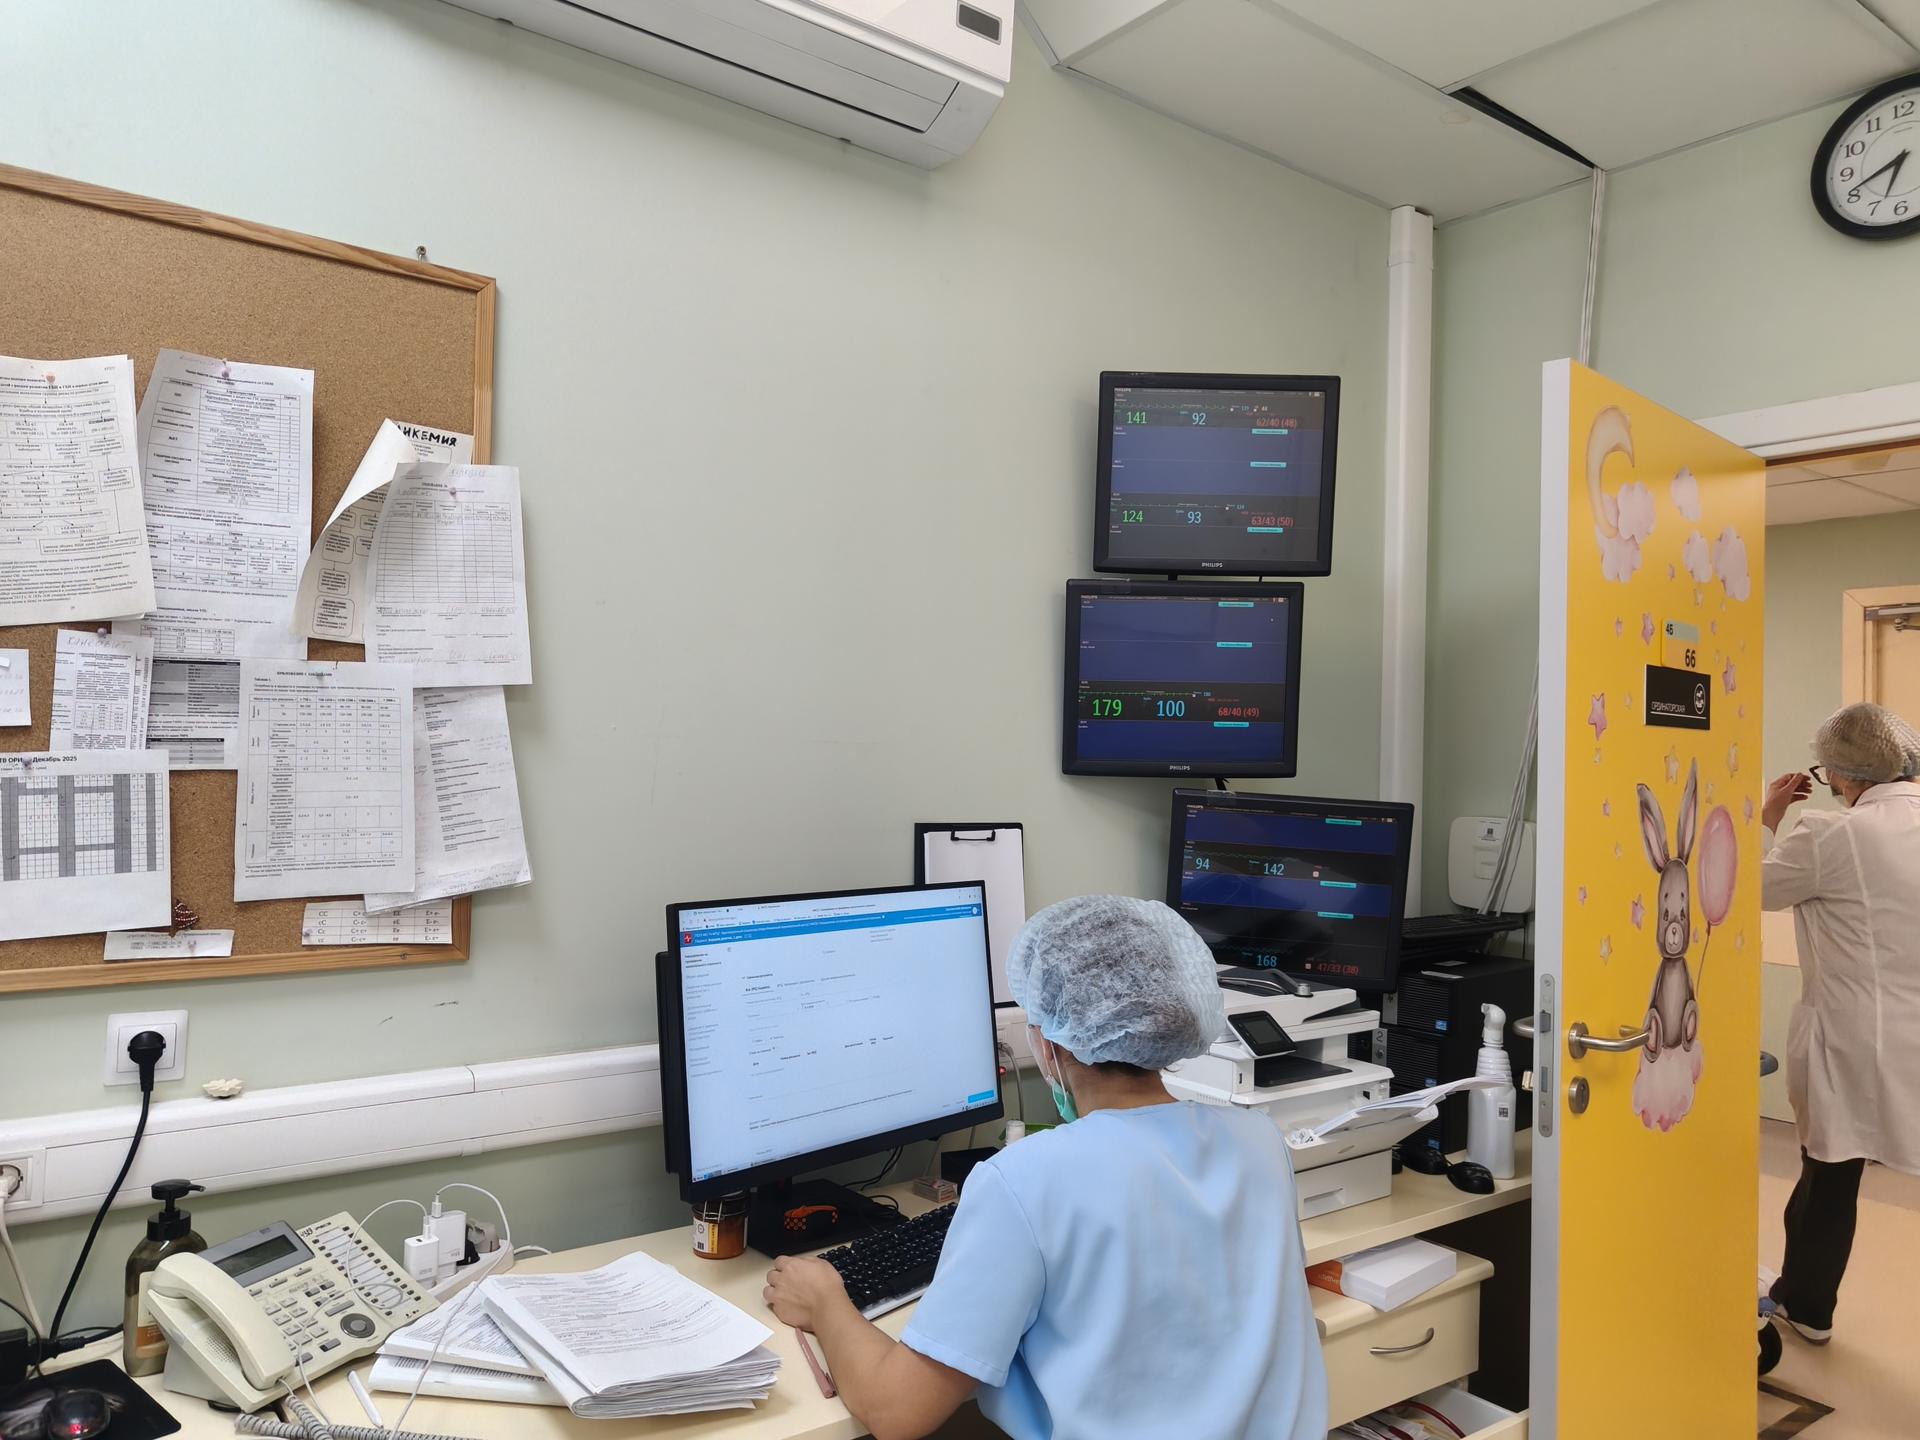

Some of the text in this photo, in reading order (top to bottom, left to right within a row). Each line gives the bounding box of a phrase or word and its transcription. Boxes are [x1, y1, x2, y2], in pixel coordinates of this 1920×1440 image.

[1893, 100, 1915, 119] 12
[1866, 117, 1881, 133] 11
[1845, 140, 1866, 158] 10
[1840, 167, 1854, 182] 9
[1847, 190, 1861, 204] 8
[1868, 200, 1881, 216] 7
[1893, 200, 1908, 216] 6
[1127, 411, 1147, 424] 141
[1192, 412, 1207, 425] 92
[397, 425, 457, 447] ИКЕМИЯ
[1122, 510, 1144, 523] 124
[1187, 511, 1202, 524] 93
[1251, 517, 1275, 526] 63/43
[1685, 649, 1696, 667] 66
[1092, 699, 1122, 717] 179
[1156, 700, 1185, 717] 100
[1218, 707, 1260, 717] 68/40 (49)
[32, 756, 61, 764] Декабрь
[1195, 858, 1210, 870] 94
[1263, 863, 1284, 876] 142
[1256, 955, 1277, 967] 168
